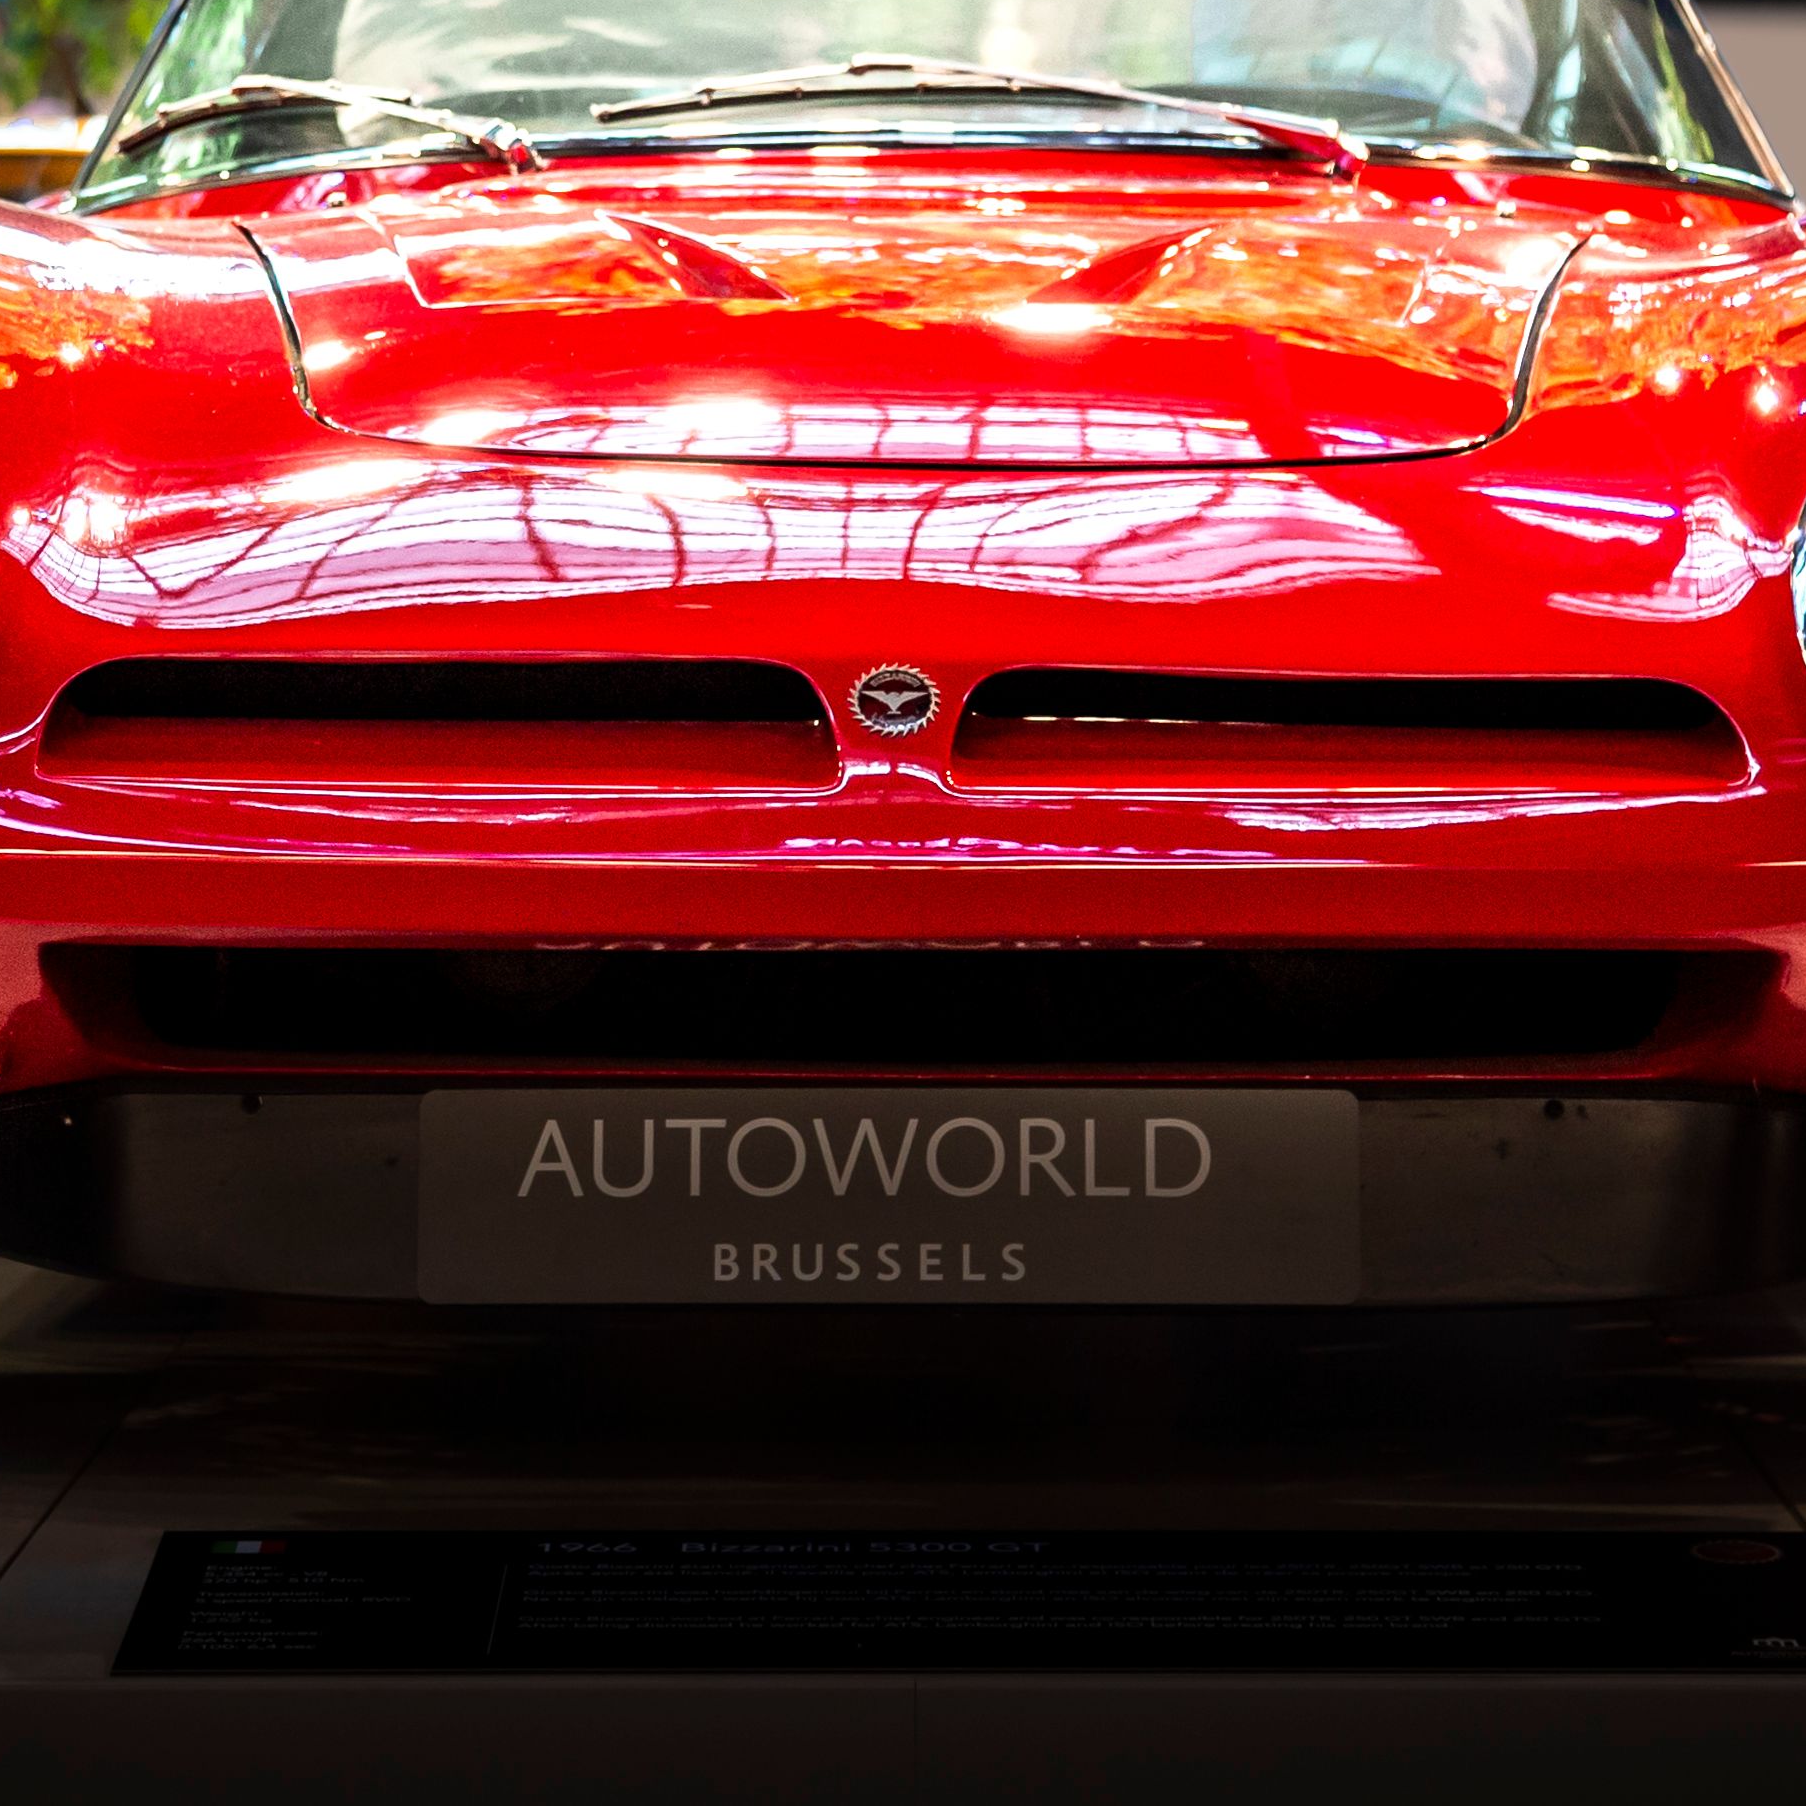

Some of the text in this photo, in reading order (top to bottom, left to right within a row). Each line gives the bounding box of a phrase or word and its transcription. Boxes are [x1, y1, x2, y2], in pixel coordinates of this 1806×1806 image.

[518, 1117, 1211, 1197] AUTOWORLD
[713, 1243, 1026, 1281] BRUSSELS
[538, 1542, 636, 1552] 1966
[869, 1542, 970, 1552] 5300
[988, 1542, 1048, 1552] GT
